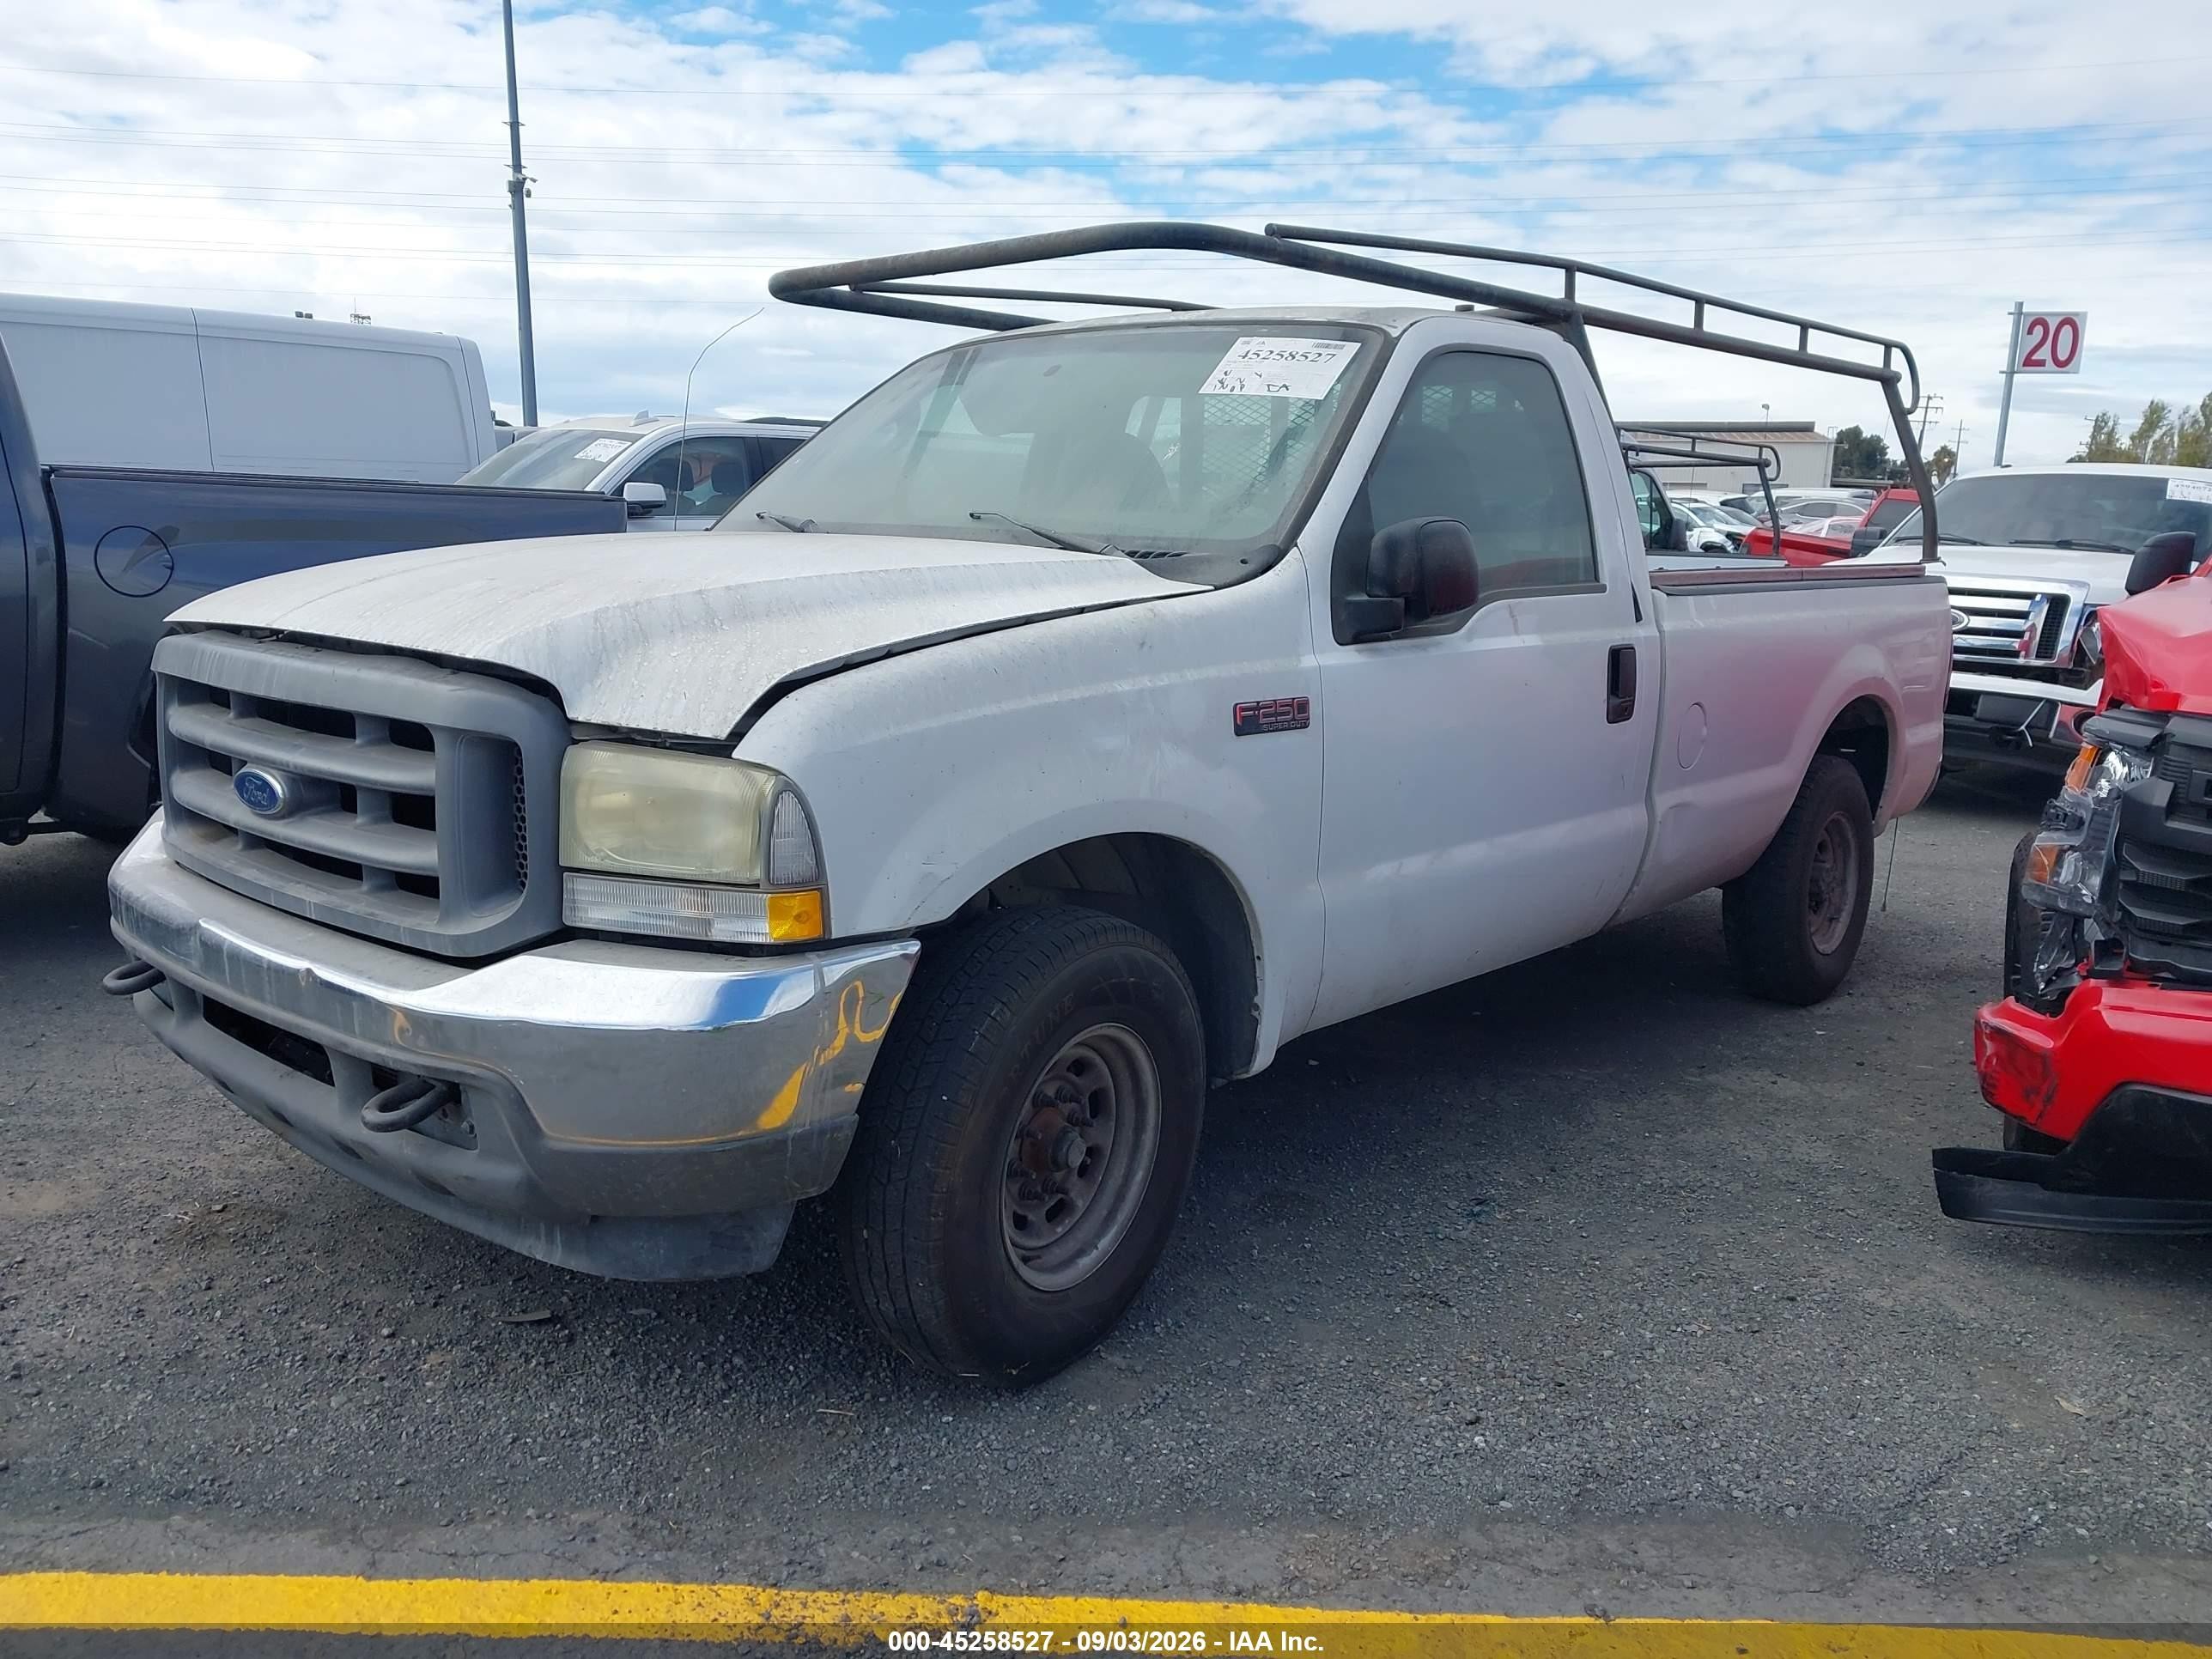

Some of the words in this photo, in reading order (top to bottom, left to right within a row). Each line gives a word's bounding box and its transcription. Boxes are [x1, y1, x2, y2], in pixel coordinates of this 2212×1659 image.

[2021, 316, 2080, 368] 20
[1237, 349, 1337, 363] 45258527
[1263, 722, 1289, 732] SUPER
[1290, 720, 1310, 728] DUTY
[243, 776, 270, 805] Ford
